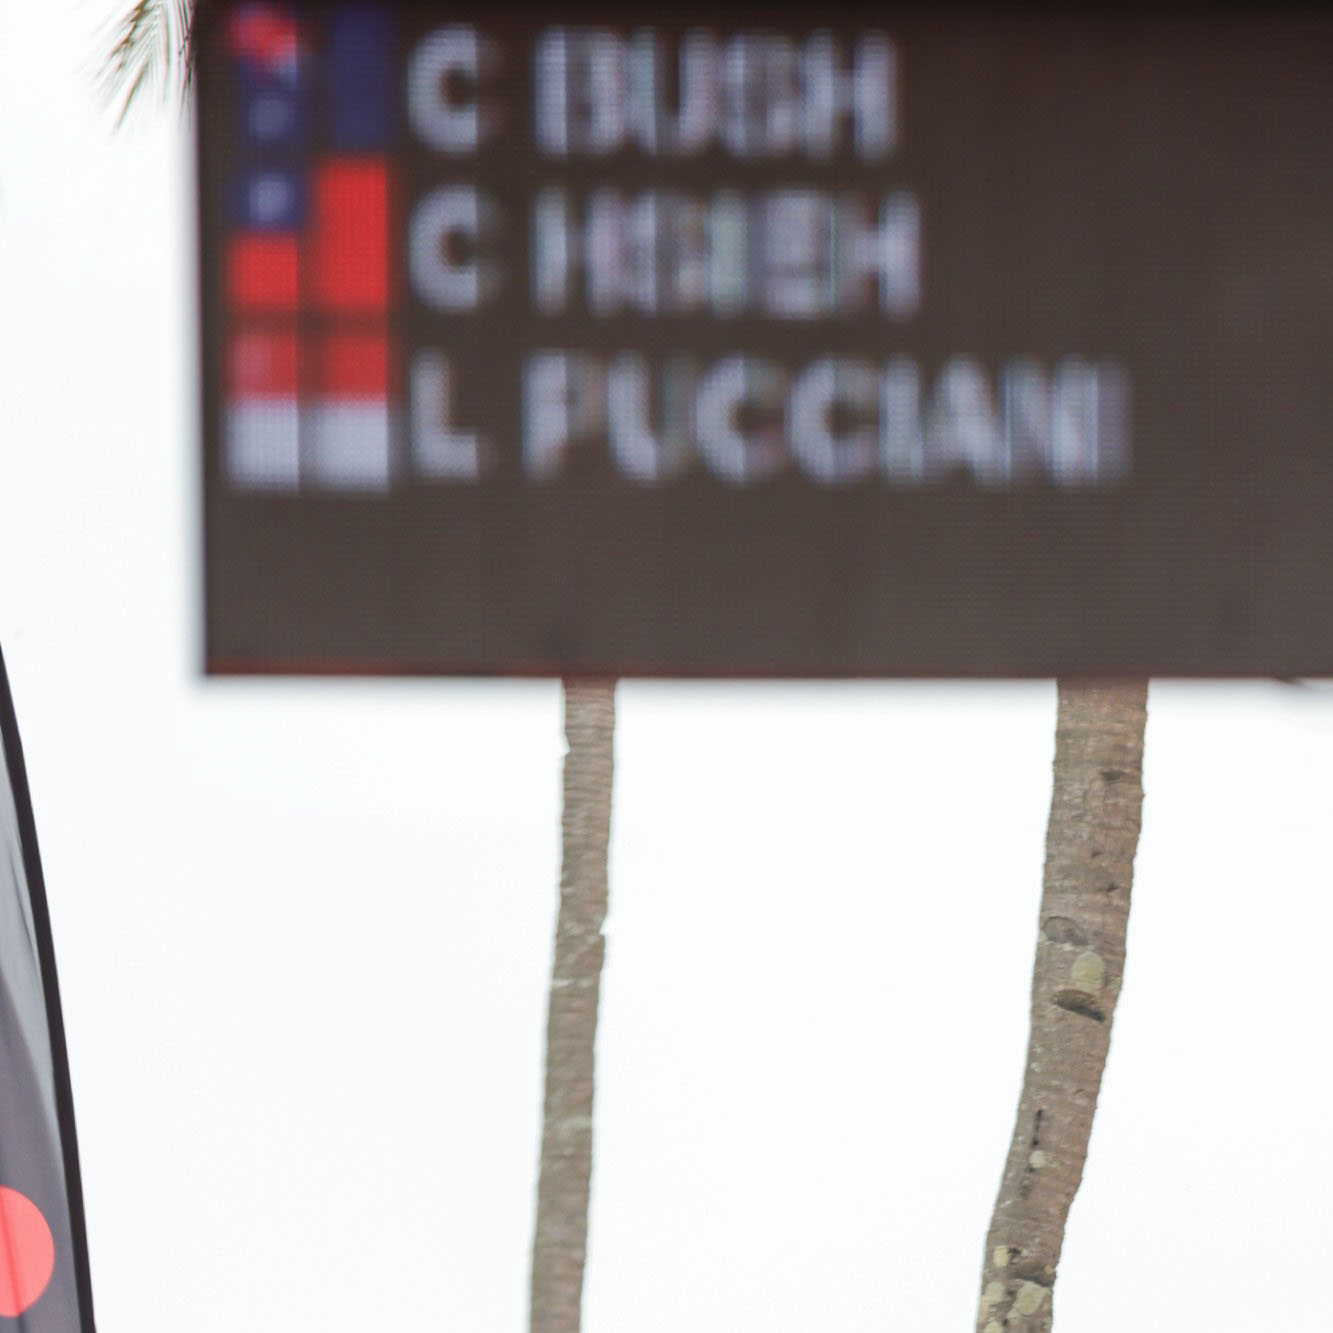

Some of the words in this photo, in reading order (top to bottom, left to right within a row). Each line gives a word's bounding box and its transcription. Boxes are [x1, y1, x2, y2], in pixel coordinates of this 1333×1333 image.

[408, 27, 482, 155] C
[534, 26, 902, 160] BUSH
[408, 186, 482, 313] C
[408, 348, 482, 482] L
